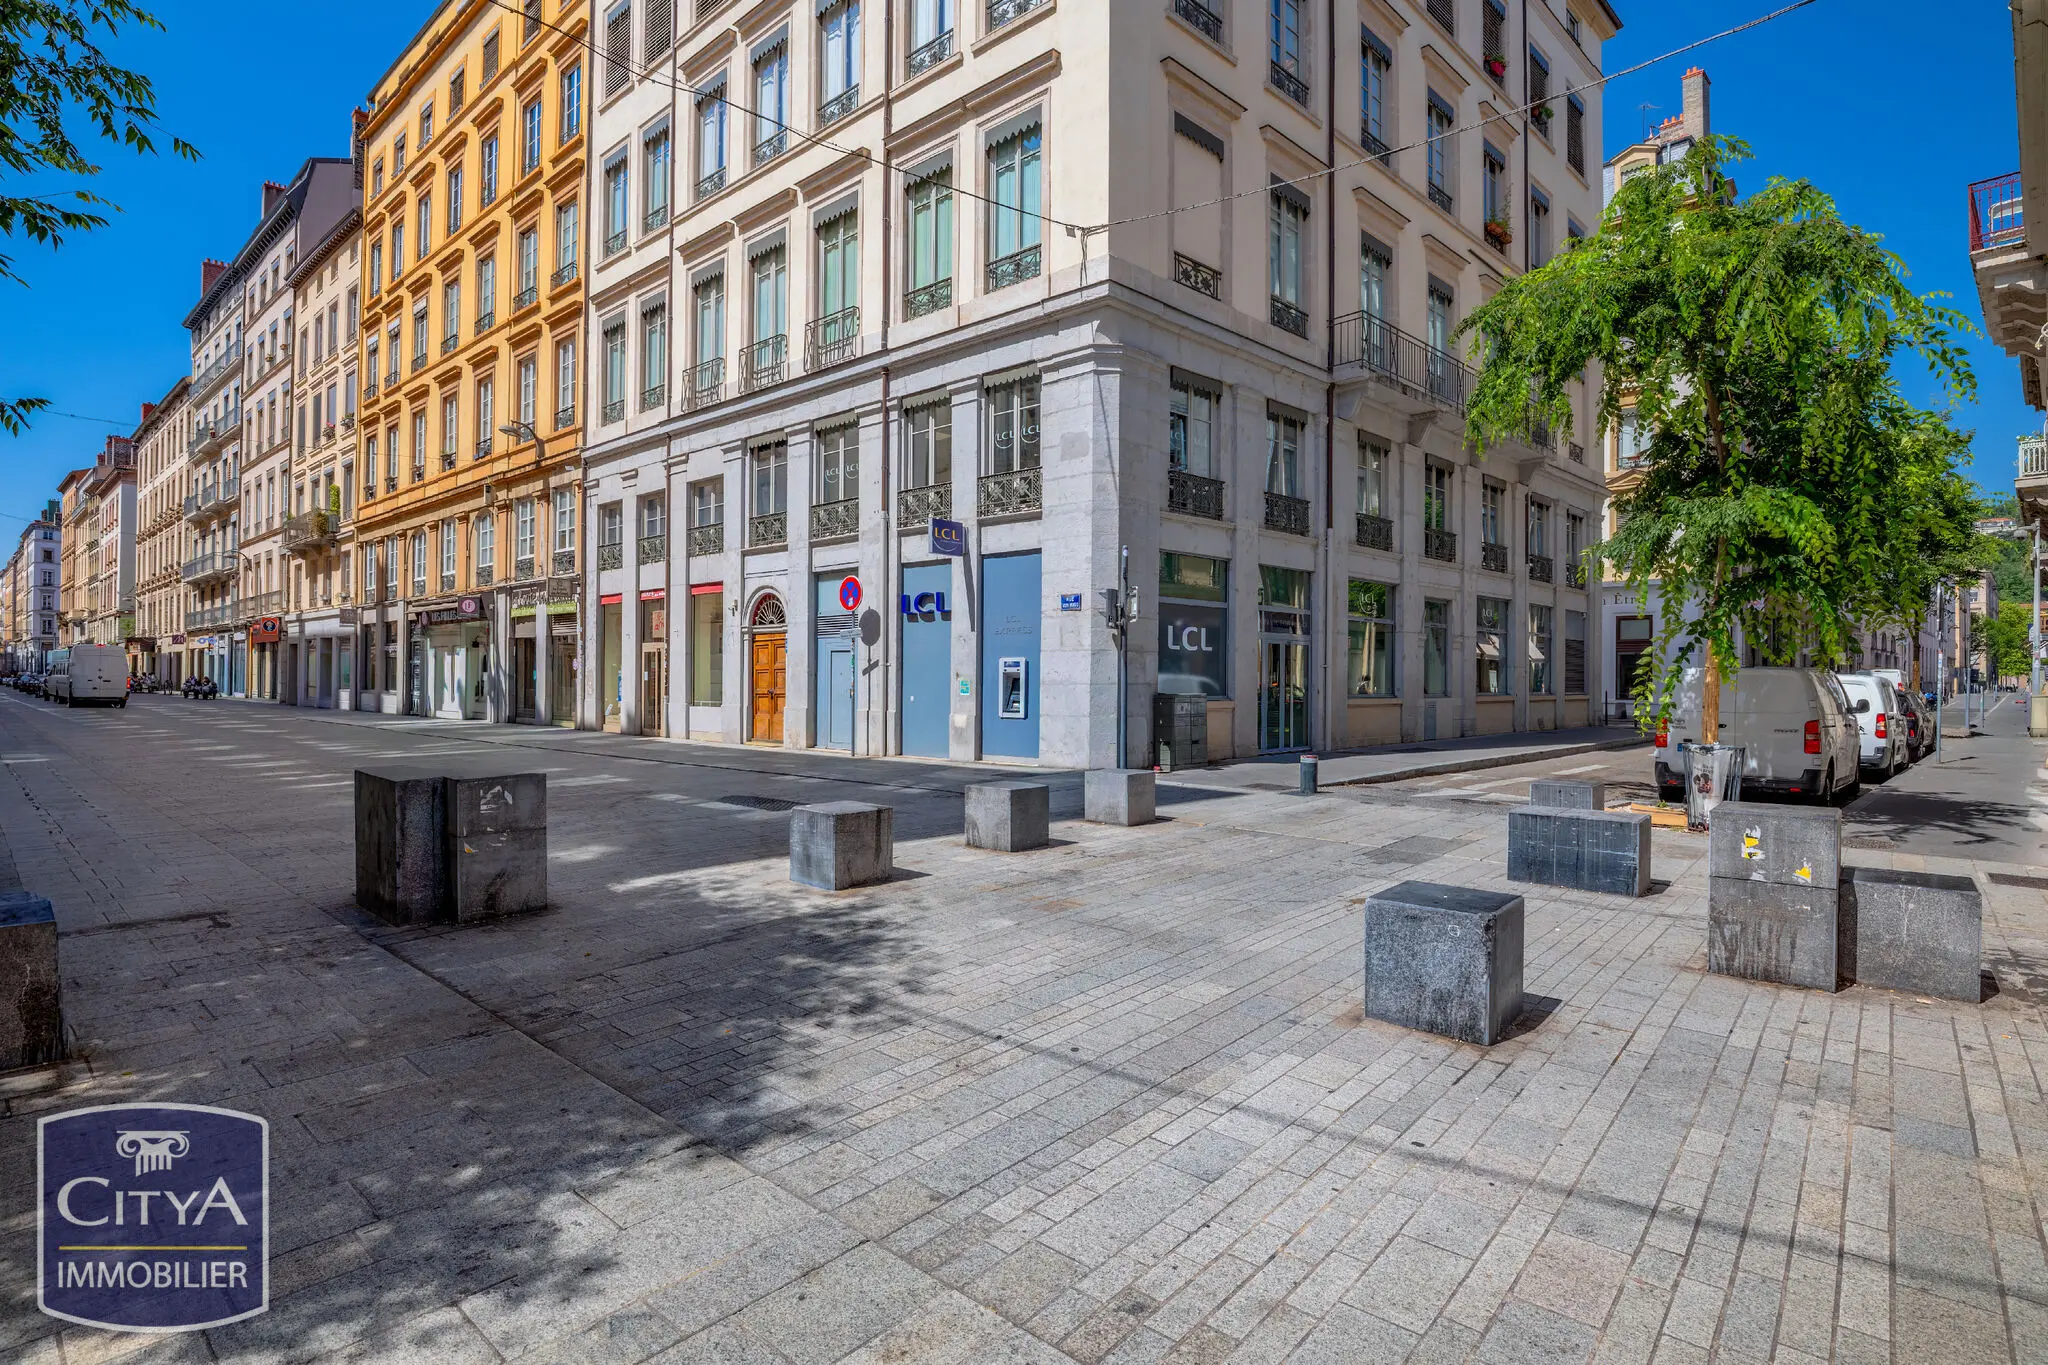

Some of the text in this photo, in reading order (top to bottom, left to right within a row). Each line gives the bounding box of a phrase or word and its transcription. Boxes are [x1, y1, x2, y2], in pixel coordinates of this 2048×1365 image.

[934, 527, 960, 541] LCL
[902, 592, 951, 615] LCL
[1167, 625, 1213, 652] LCL
